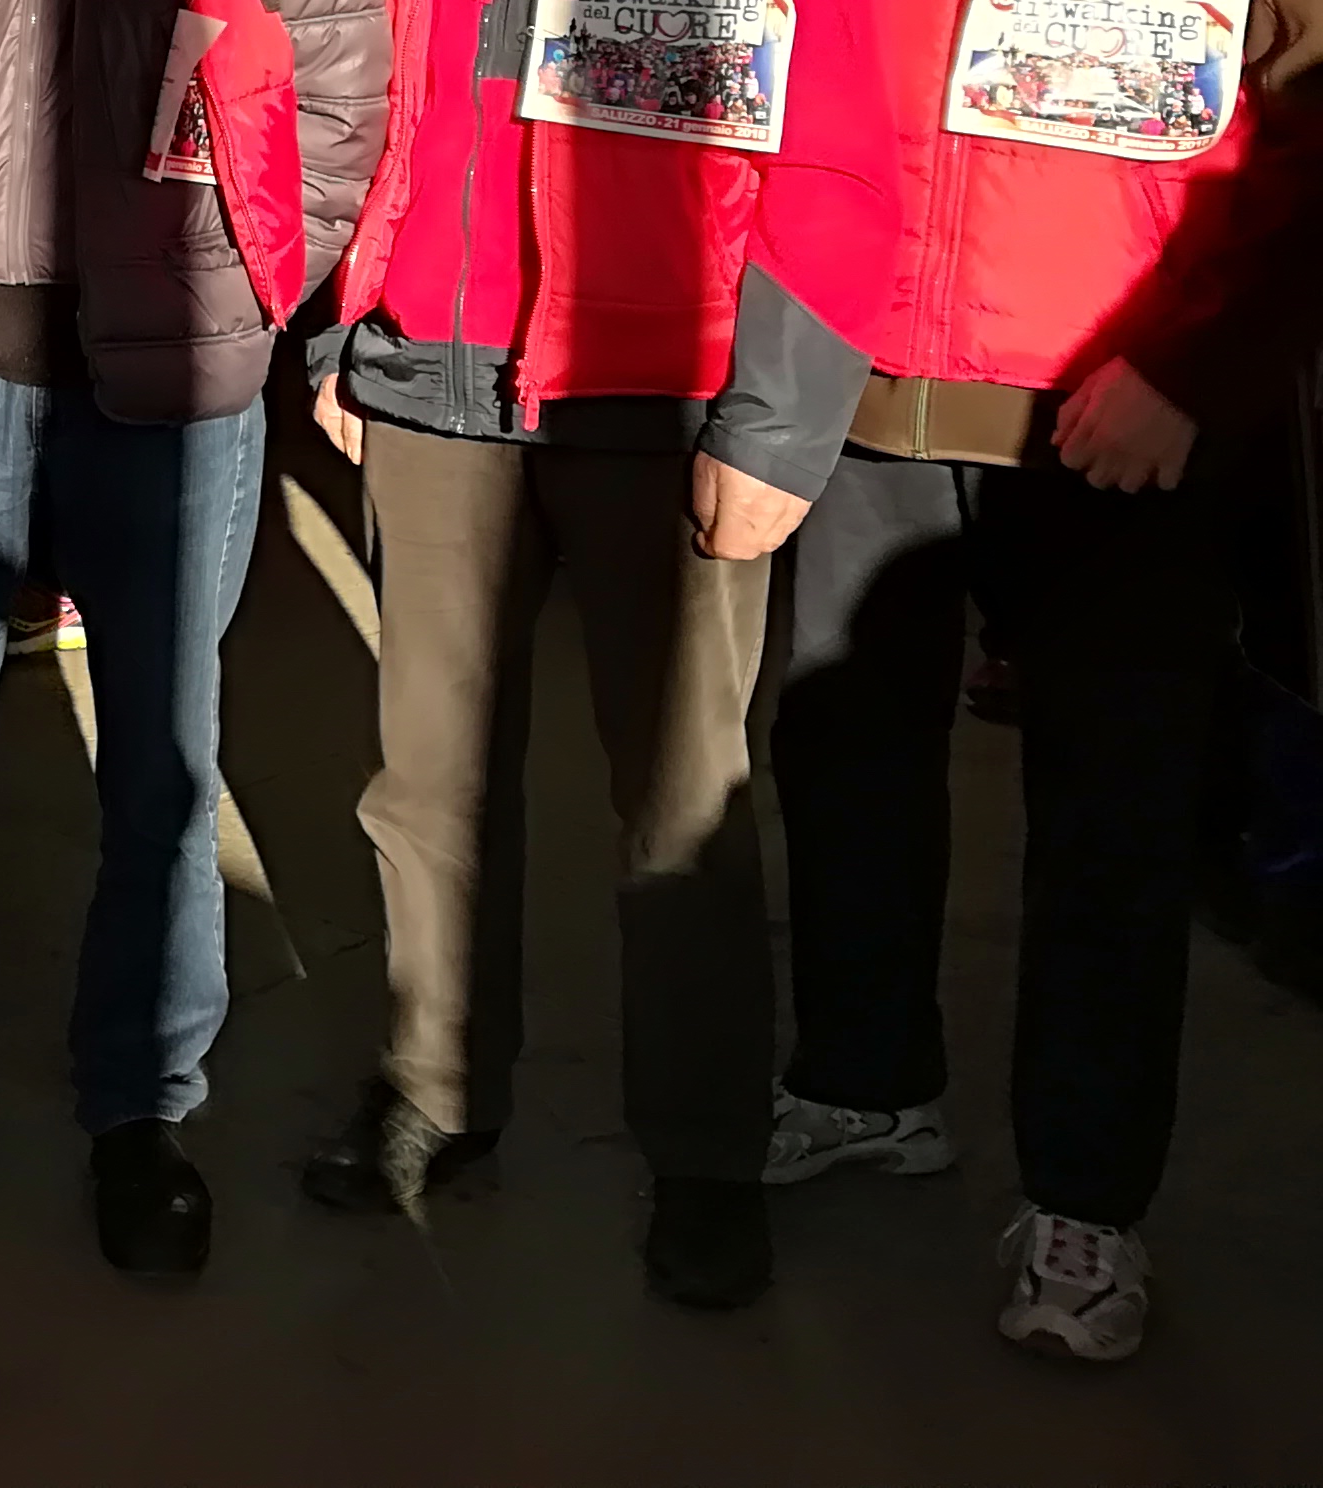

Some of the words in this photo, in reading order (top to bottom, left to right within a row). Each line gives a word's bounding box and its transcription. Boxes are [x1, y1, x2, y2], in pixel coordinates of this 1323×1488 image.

[583, 5, 612, 20] del
[591, 107, 658, 127] SALUZZO
[664, 118, 680, 129] 21
[682, 120, 733, 136] gennaio
[734, 127, 768, 141] 2018
